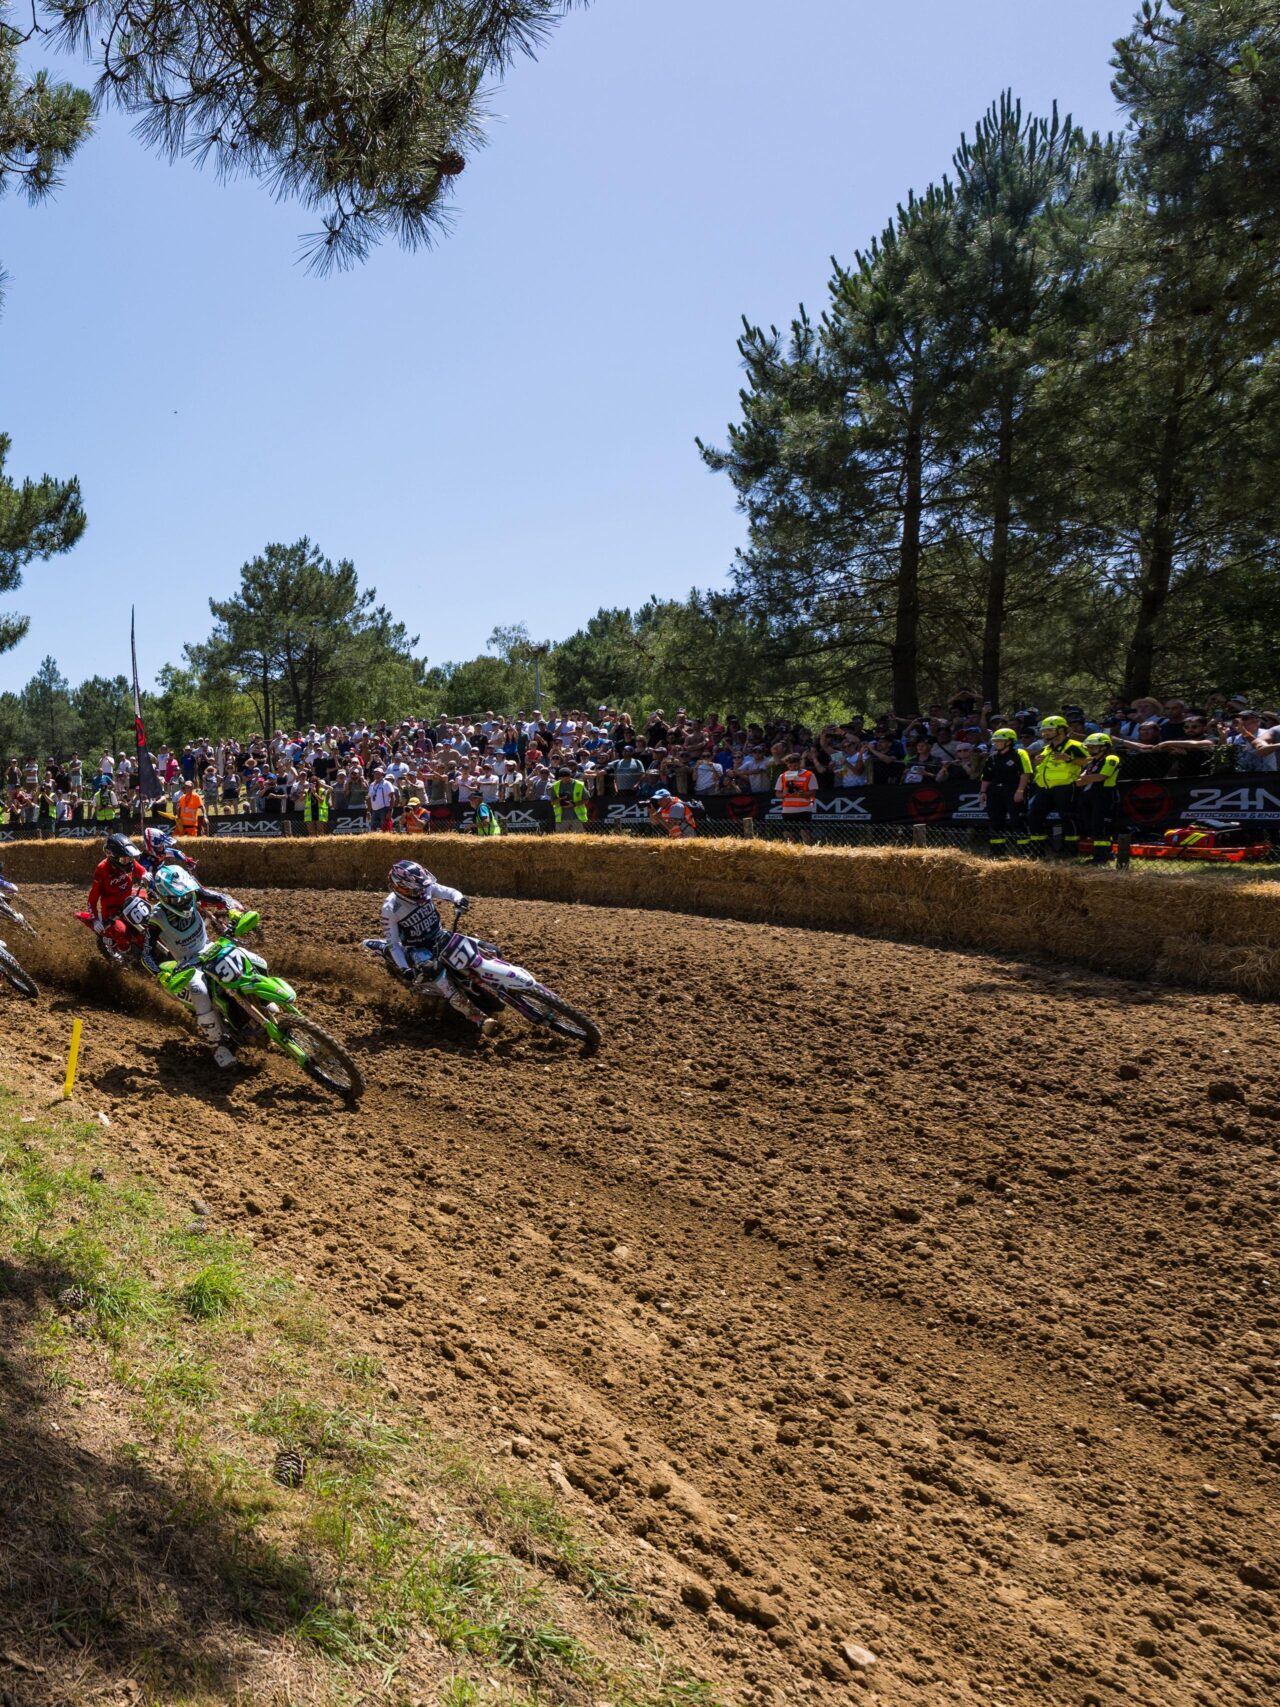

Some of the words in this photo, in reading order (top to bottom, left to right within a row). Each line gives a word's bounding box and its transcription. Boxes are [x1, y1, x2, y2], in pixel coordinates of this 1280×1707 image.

[217, 820, 281, 833] 24MX
[130, 902, 150, 921] 66
[215, 947, 248, 983] 317
[448, 937, 476, 970] 57
